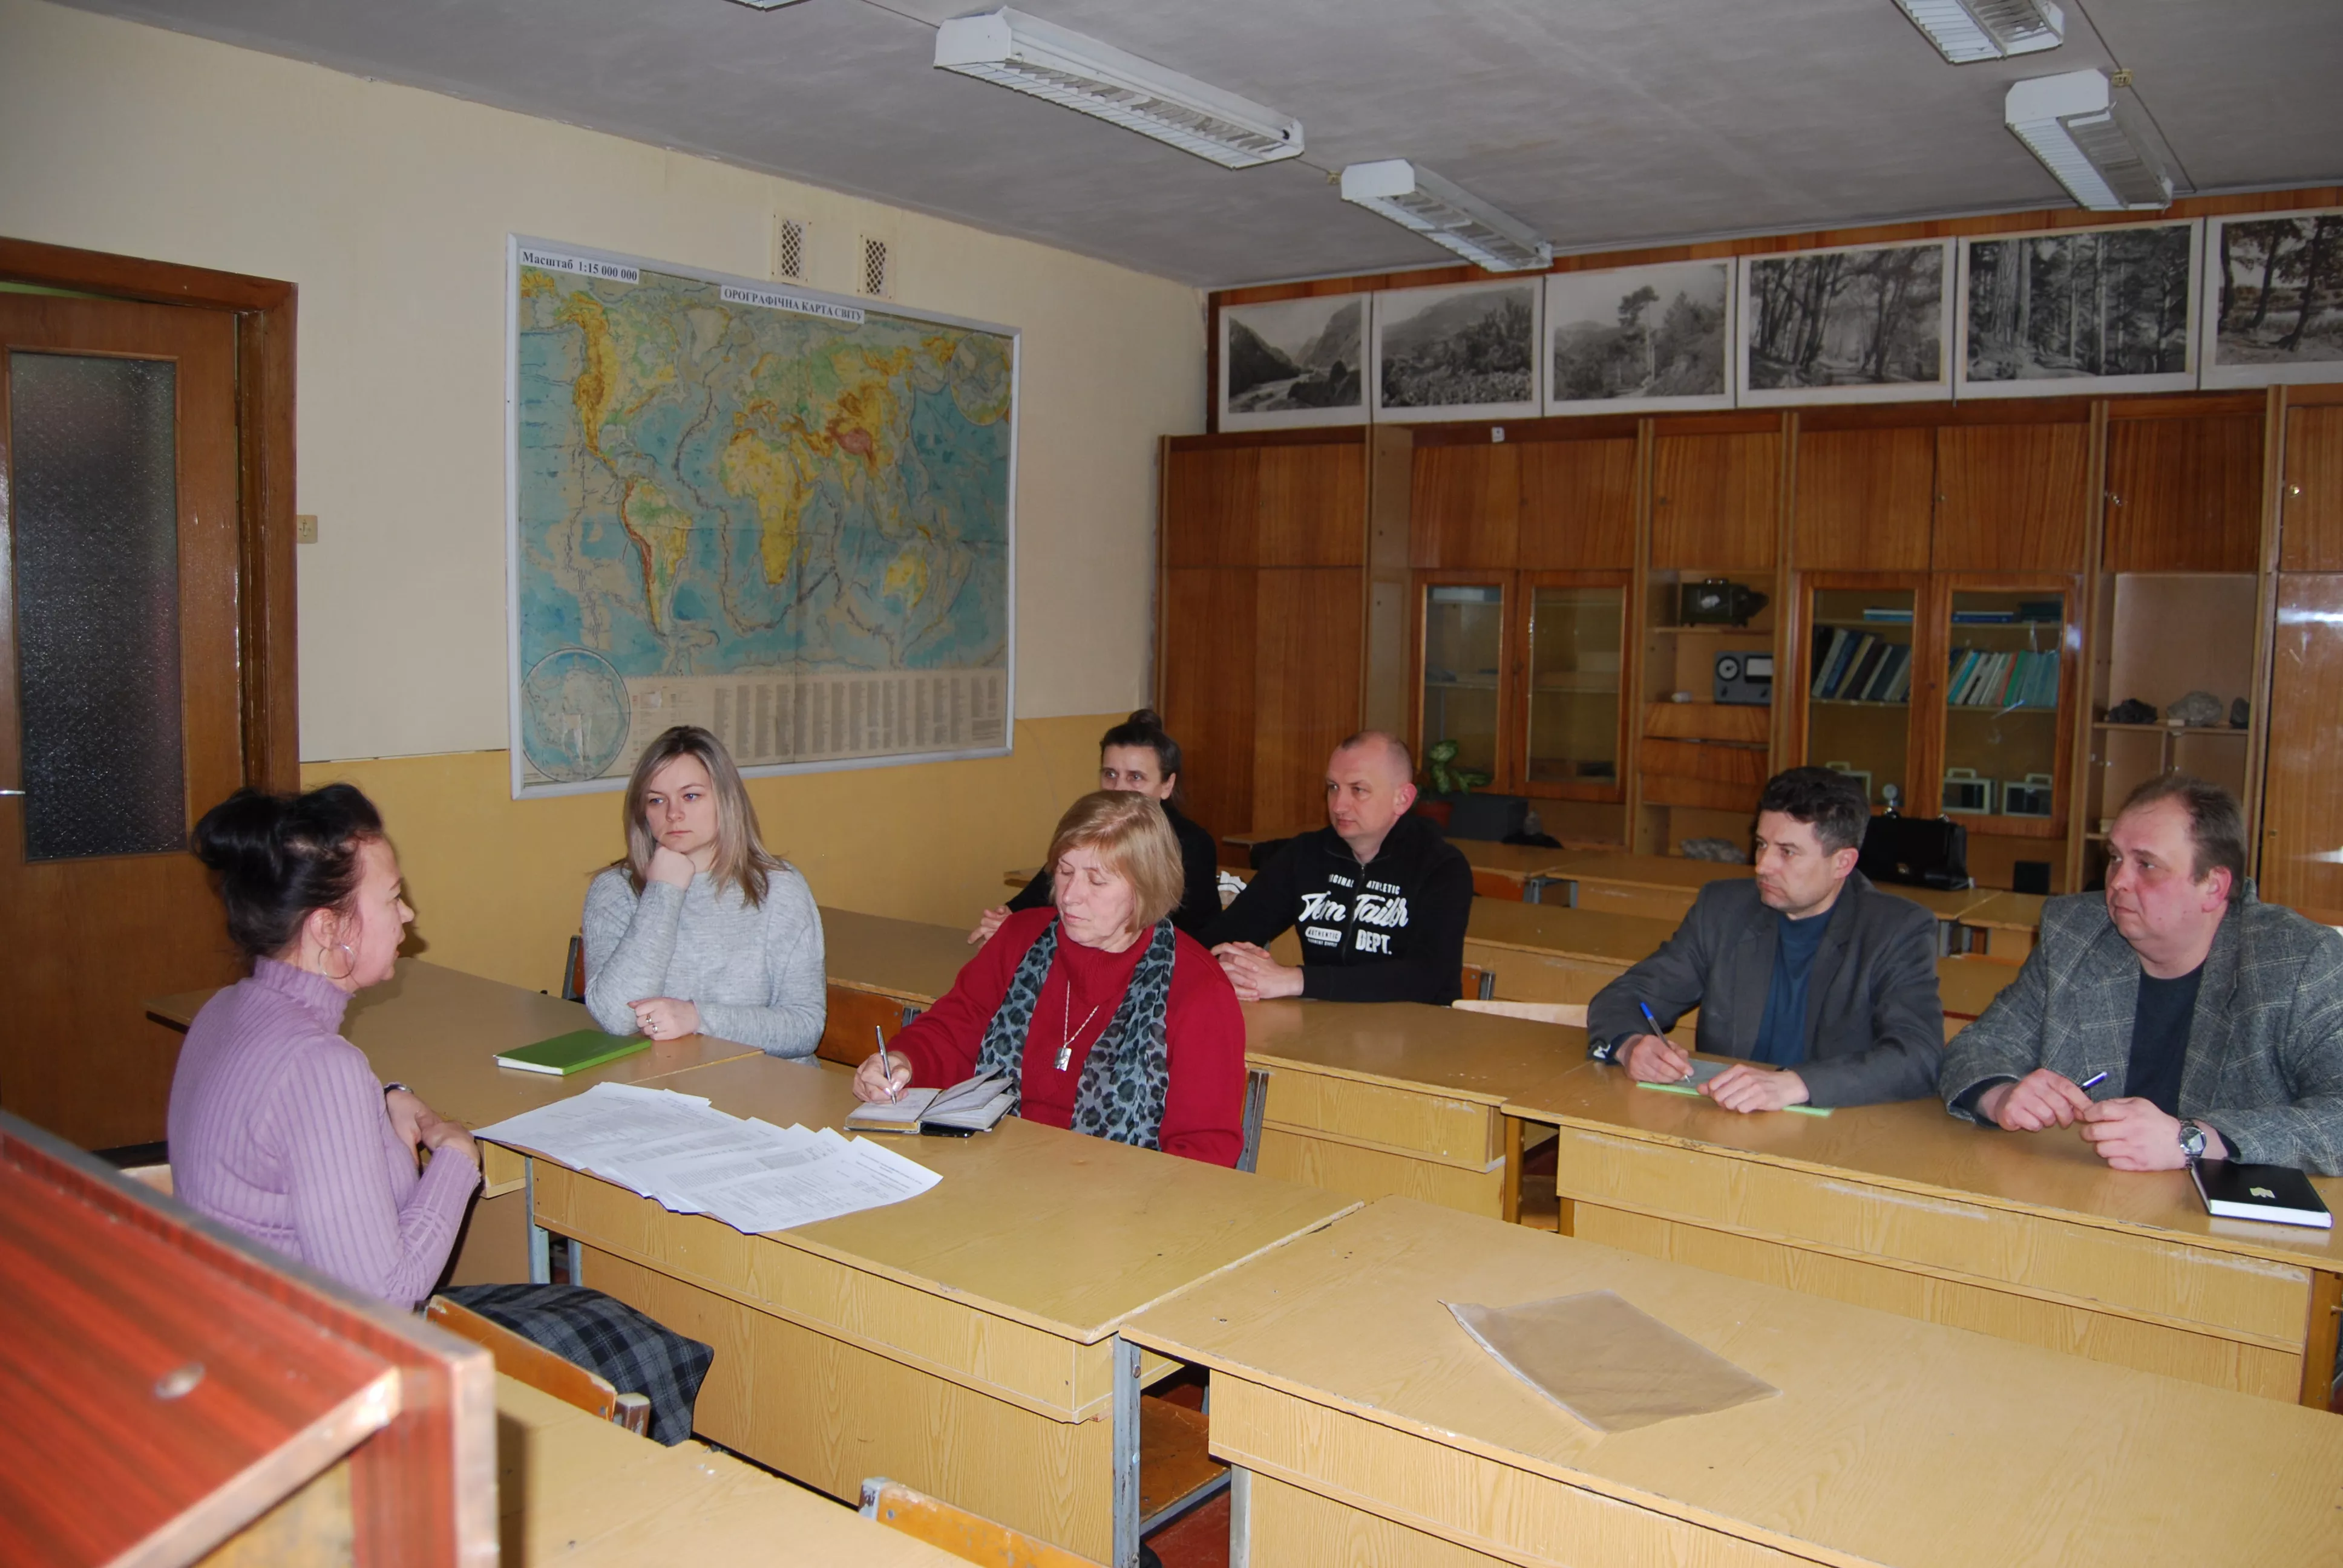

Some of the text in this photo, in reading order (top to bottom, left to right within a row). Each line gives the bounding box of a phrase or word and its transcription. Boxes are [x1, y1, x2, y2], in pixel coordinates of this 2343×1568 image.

[523, 251, 637, 281] Масштаб 1:15 000 000
[724, 288, 863, 321] ОРОГРАФІЧНА КАРТА СВІТУ
[1366, 881, 1400, 894] ATHLETIC
[1308, 929, 1339, 939] AUTHENTIC
